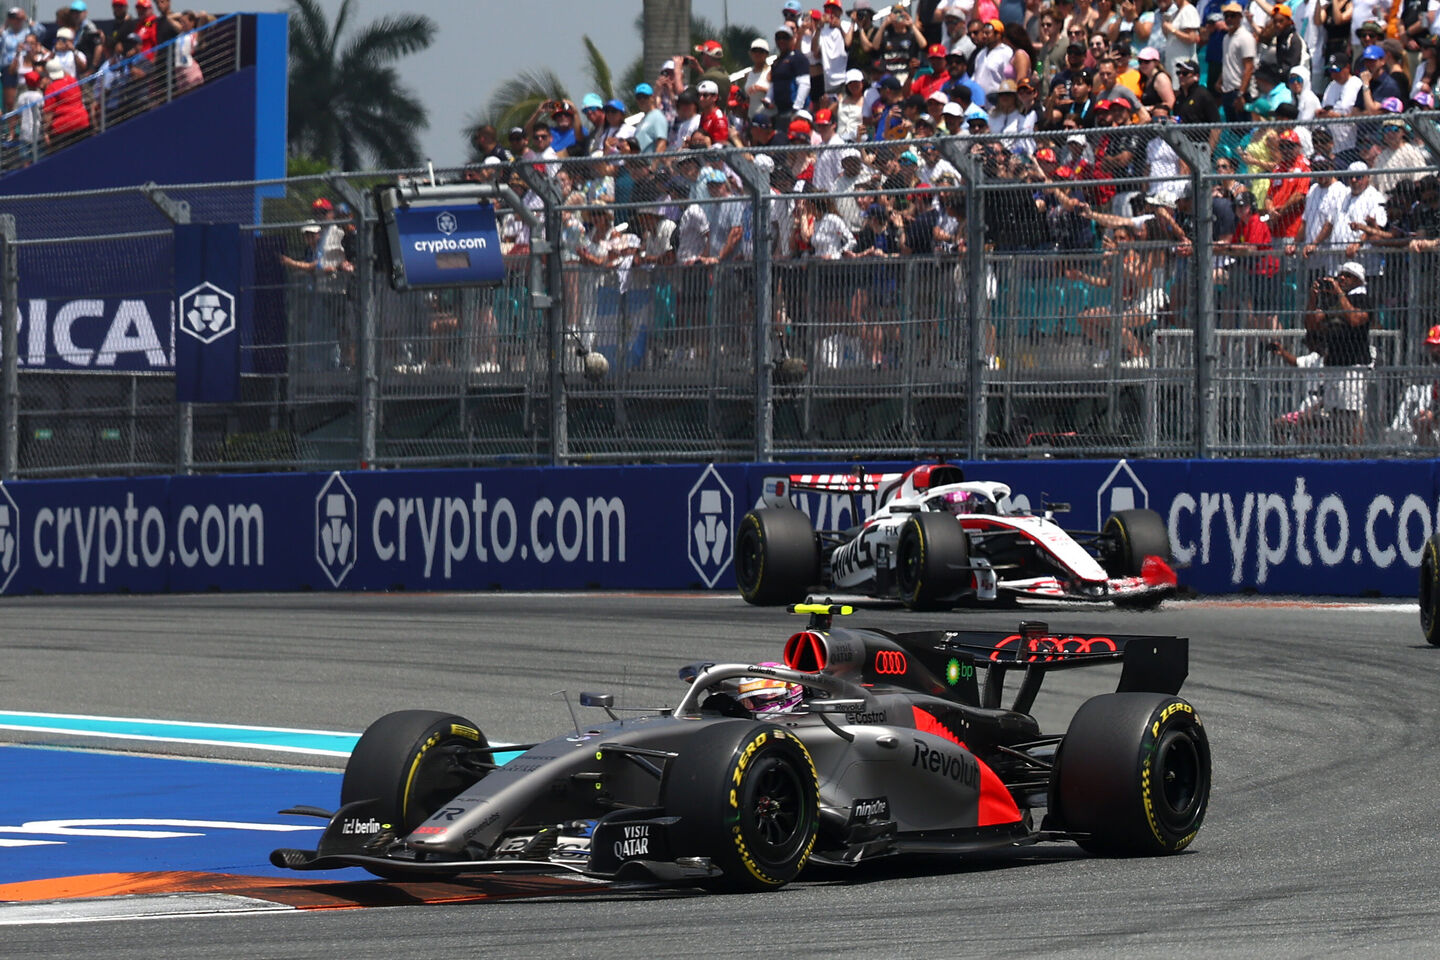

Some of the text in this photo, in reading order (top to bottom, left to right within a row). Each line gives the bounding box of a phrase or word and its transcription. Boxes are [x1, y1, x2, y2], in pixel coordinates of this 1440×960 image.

[414, 237, 487, 254] crypto.com
[16, 299, 176, 367] ICA
[33, 493, 264, 583] crypto.com
[373, 484, 626, 577] crypto.com
[961, 662, 973, 681] bp
[855, 711, 888, 725] Castrol
[1152, 702, 1193, 738] P ZERO
[729, 732, 767, 809] P ZERO
[911, 738, 980, 790] Revolut
[855, 799, 886, 820] ninjaOne
[354, 817, 381, 834] berlin
[614, 837, 649, 861] QATAR
